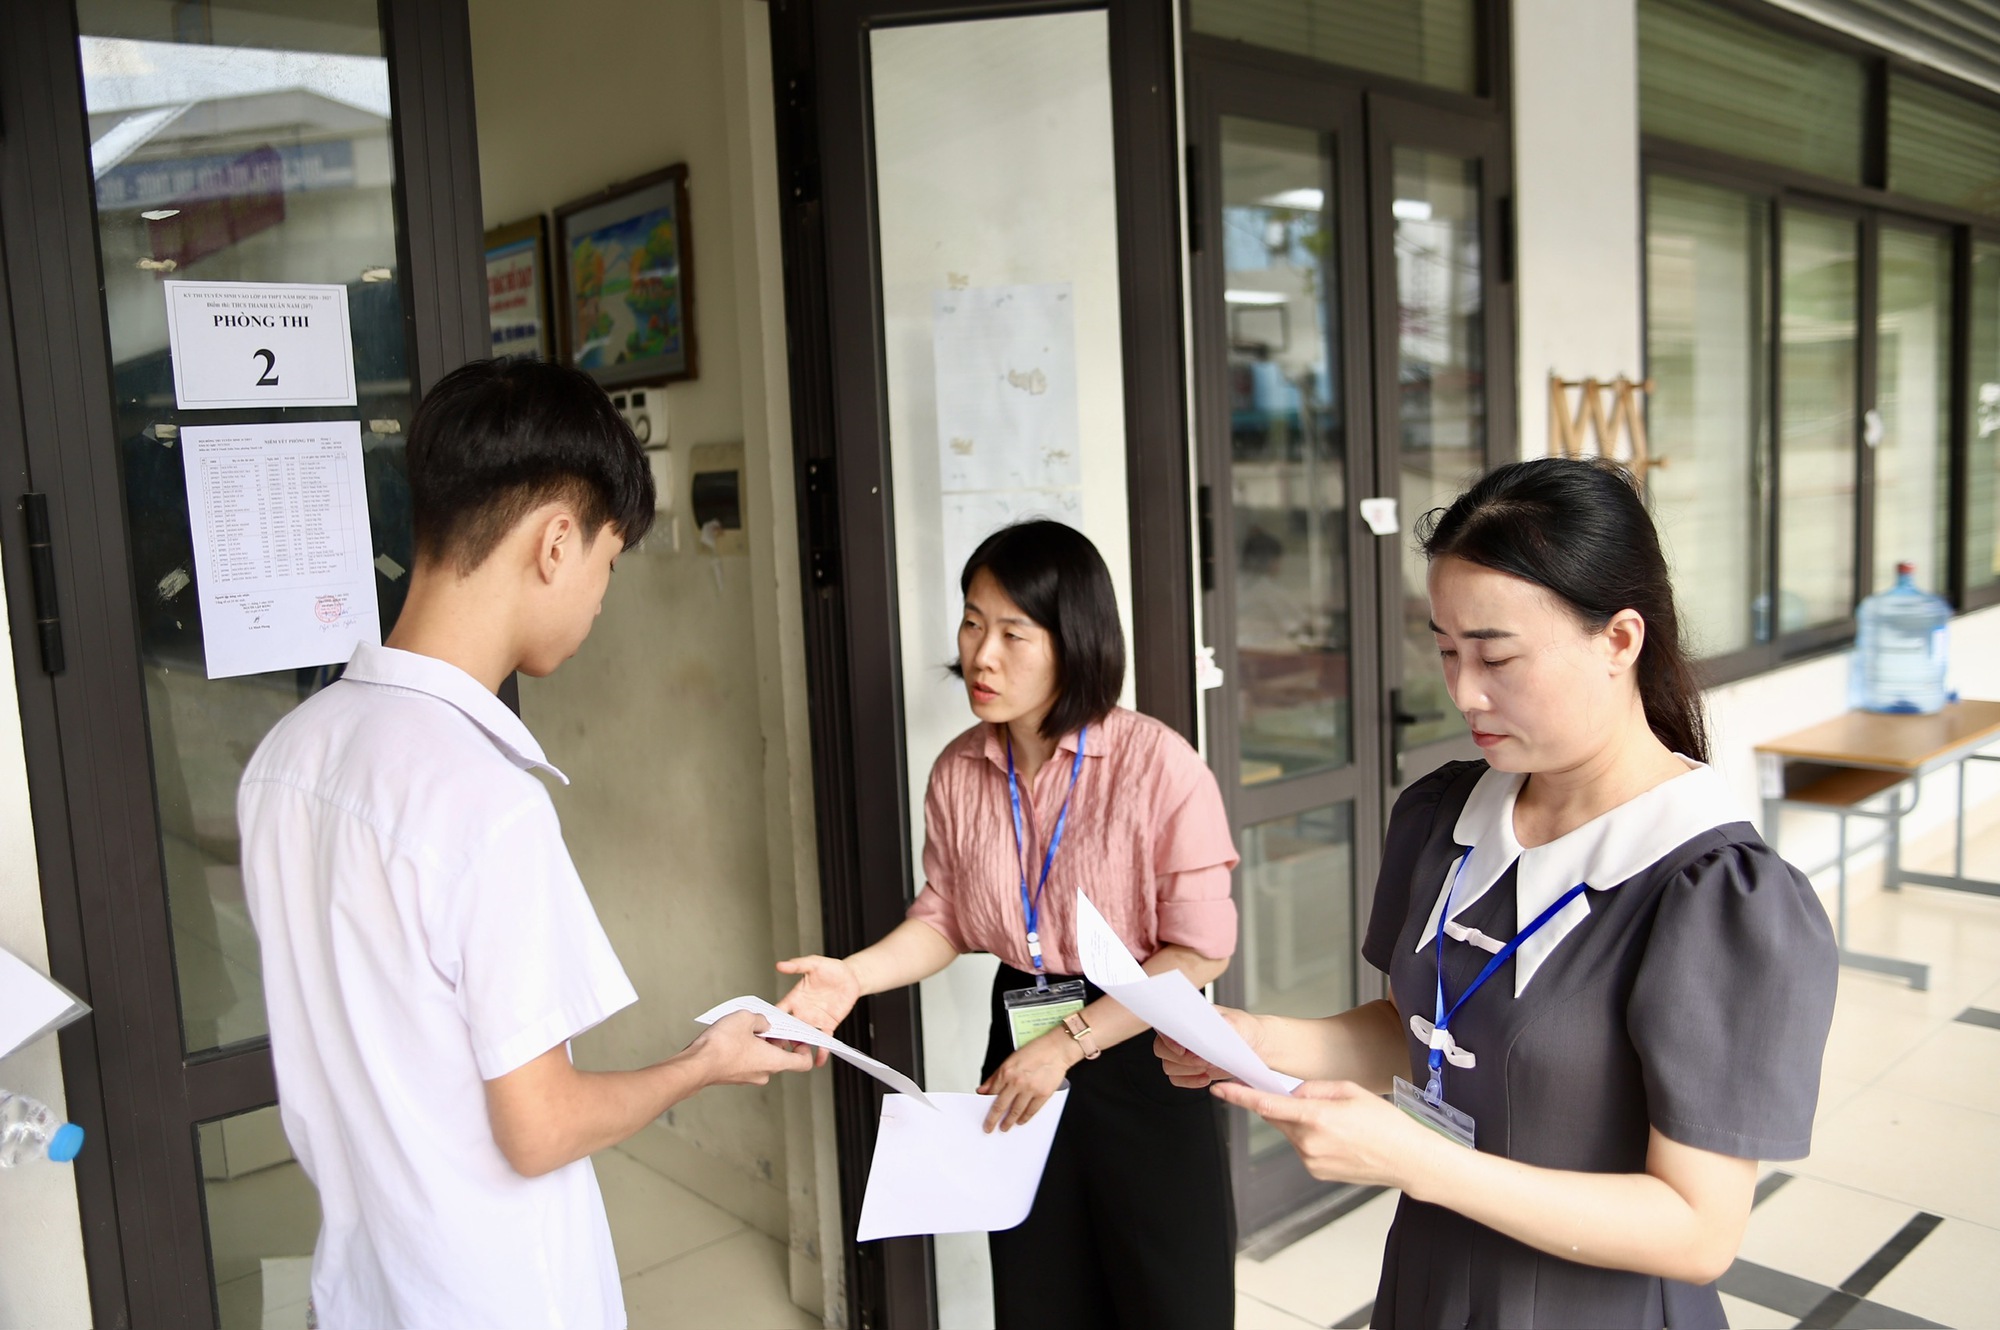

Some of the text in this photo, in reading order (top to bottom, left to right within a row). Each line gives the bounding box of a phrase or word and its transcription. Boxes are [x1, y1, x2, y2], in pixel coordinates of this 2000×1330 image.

[213, 312, 310, 328] PHÒNG THI
[253, 348, 279, 387] 2
